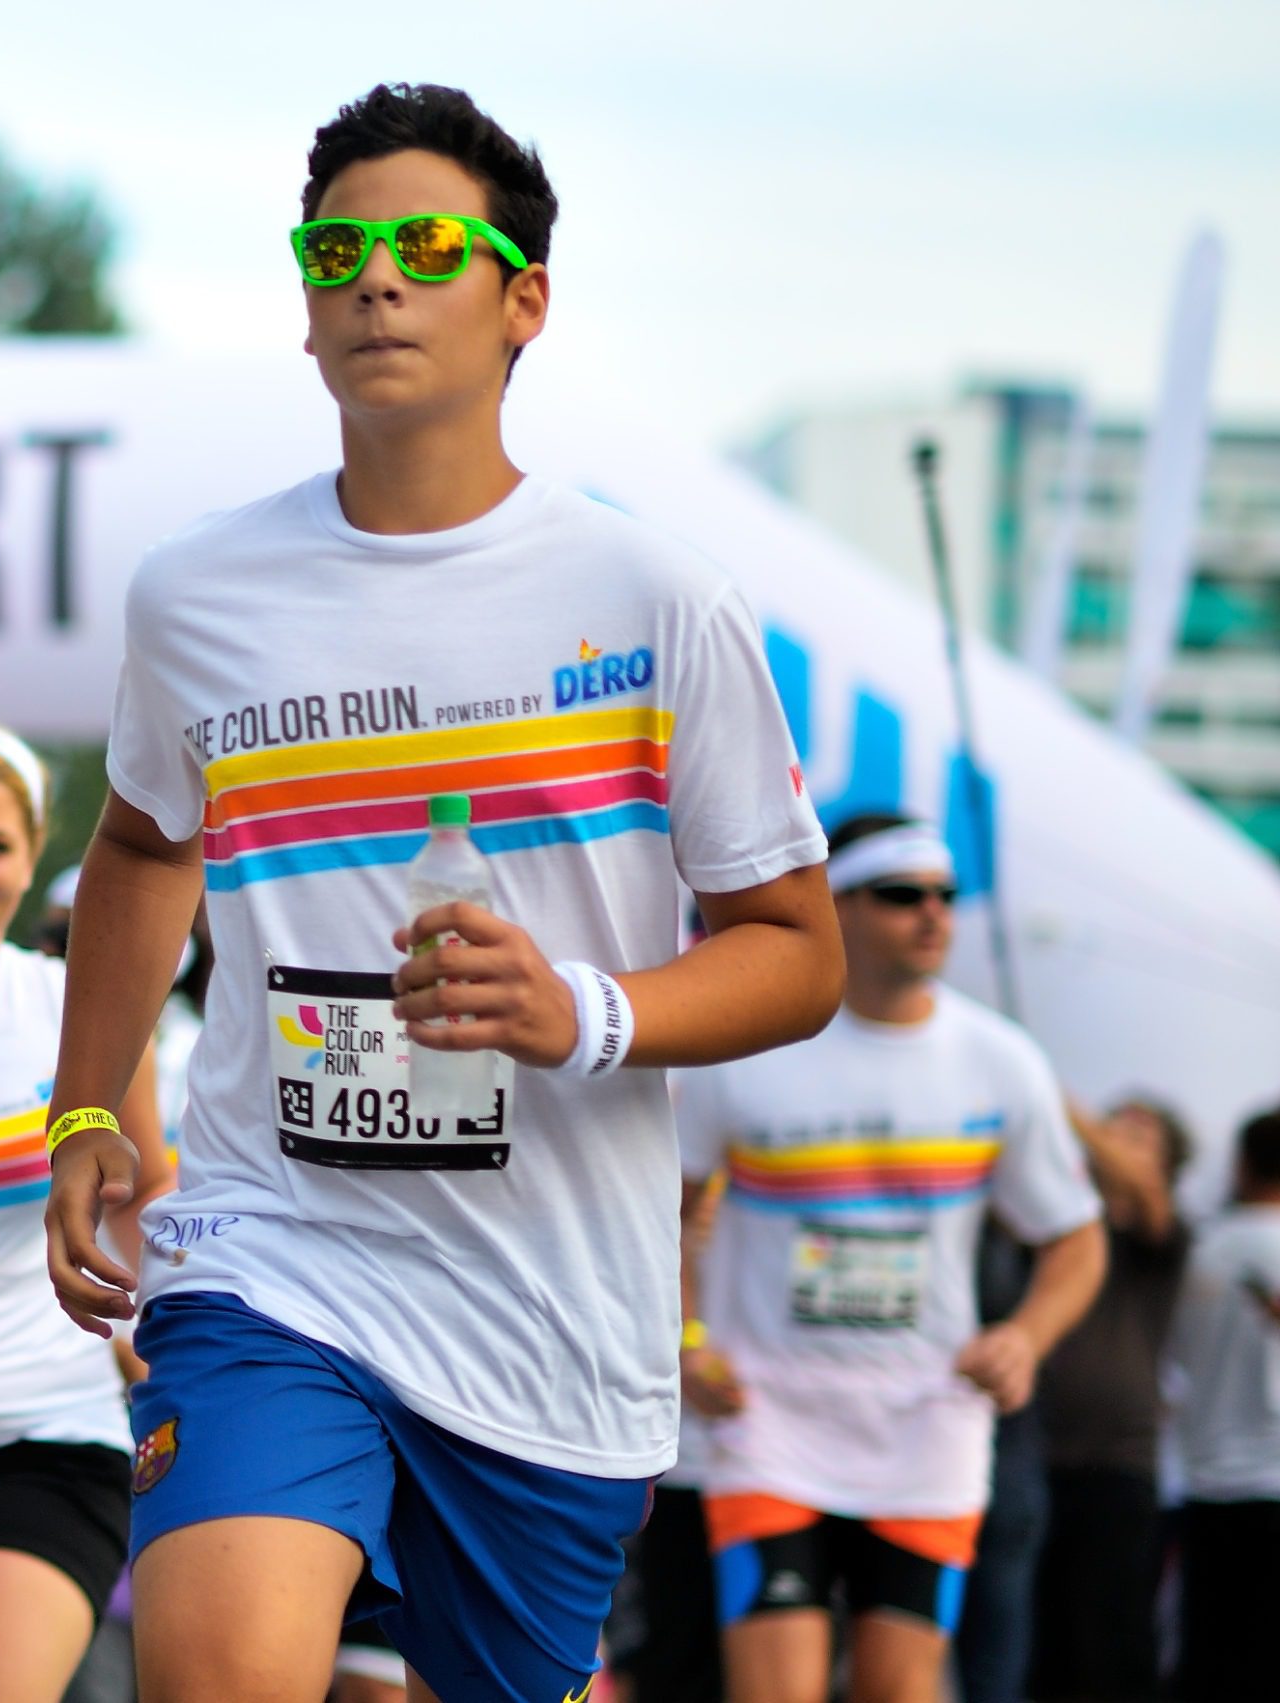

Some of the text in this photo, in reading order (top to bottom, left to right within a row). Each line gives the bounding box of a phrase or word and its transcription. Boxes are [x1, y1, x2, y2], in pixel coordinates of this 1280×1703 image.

[221, 694, 330, 754] COLOR
[436, 698, 516, 725] POWERED
[522, 694, 543, 714] BY
[552, 647, 653, 710] DERO
[326, 1004, 359, 1028] THE
[325, 1028, 384, 1053] COLOR
[84, 1112, 106, 1124] THE
[151, 1215, 240, 1250] Dove
